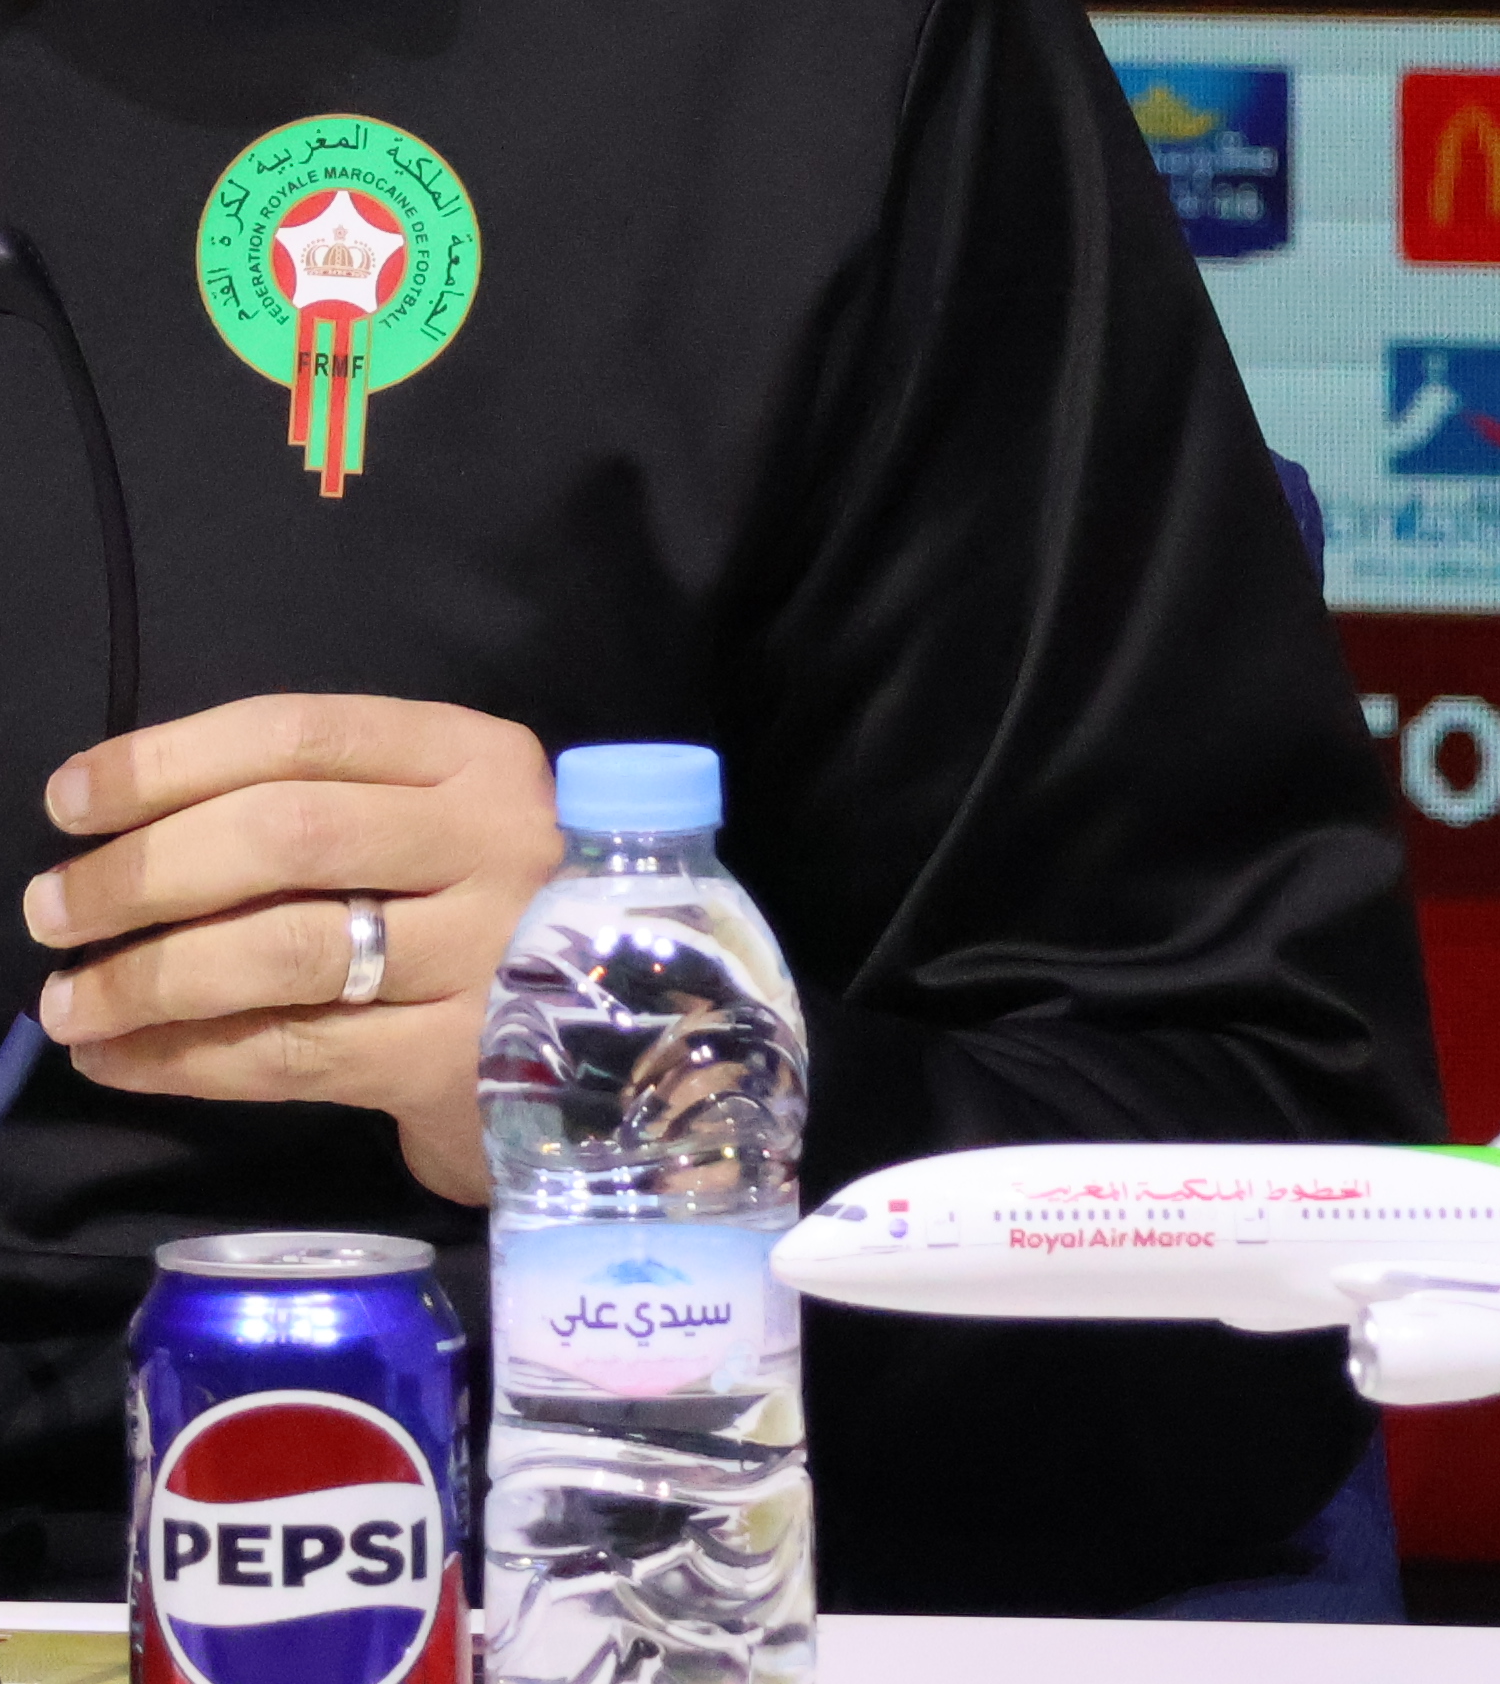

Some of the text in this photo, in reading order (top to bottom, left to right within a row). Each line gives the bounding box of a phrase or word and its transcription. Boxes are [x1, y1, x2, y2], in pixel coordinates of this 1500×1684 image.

[244, 165, 431, 330] FEDERATION ROYALE MAROCAINE DE FOOTBALL
[297, 350, 366, 380] FRMF
[1008, 1226, 1217, 1255] Royal Air Maroc
[548, 1294, 732, 1348] سيدي علي
[162, 1516, 428, 1589] PEPSI
